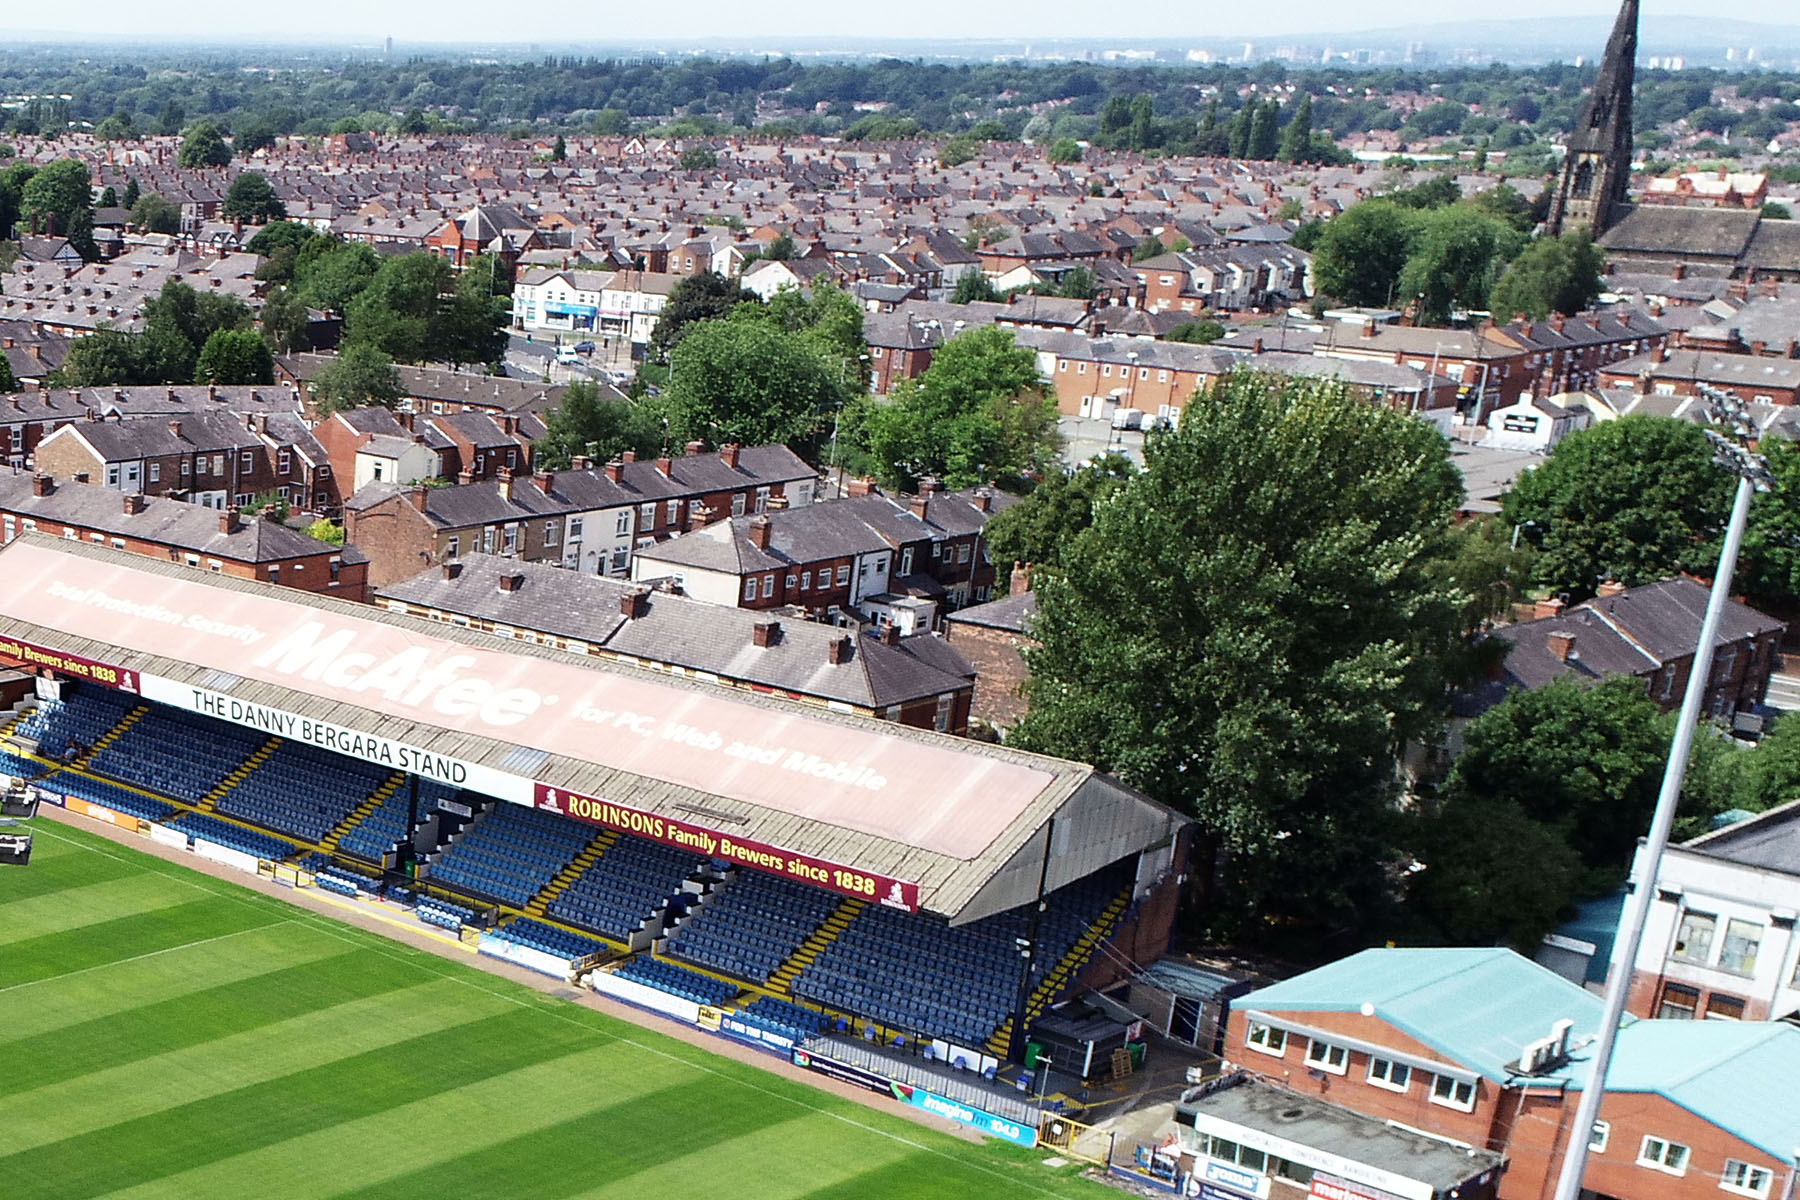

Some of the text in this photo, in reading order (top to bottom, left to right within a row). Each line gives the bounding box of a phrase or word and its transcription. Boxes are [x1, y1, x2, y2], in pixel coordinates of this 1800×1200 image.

[46, 581, 267, 645] Total Protection Security
[24, 646, 63, 672] Brewers
[64, 658, 89, 677] since
[90, 665, 116, 684] 1838
[257, 621, 542, 727] McAfee
[192, 690, 467, 784] THE DANNY BERGARA STAND
[571, 703, 611, 725] for
[662, 721, 723, 751] Web
[724, 738, 777, 766] and
[780, 751, 888, 790] Mobile
[568, 794, 663, 838] ROBINSONS
[667, 824, 718, 855] Family
[720, 838, 784, 871] Brewers
[787, 858, 828, 883] since
[833, 870, 876, 896] 1838
[730, 1021, 745, 1033] FOR
[990, 1119, 1020, 1139] 104.9
